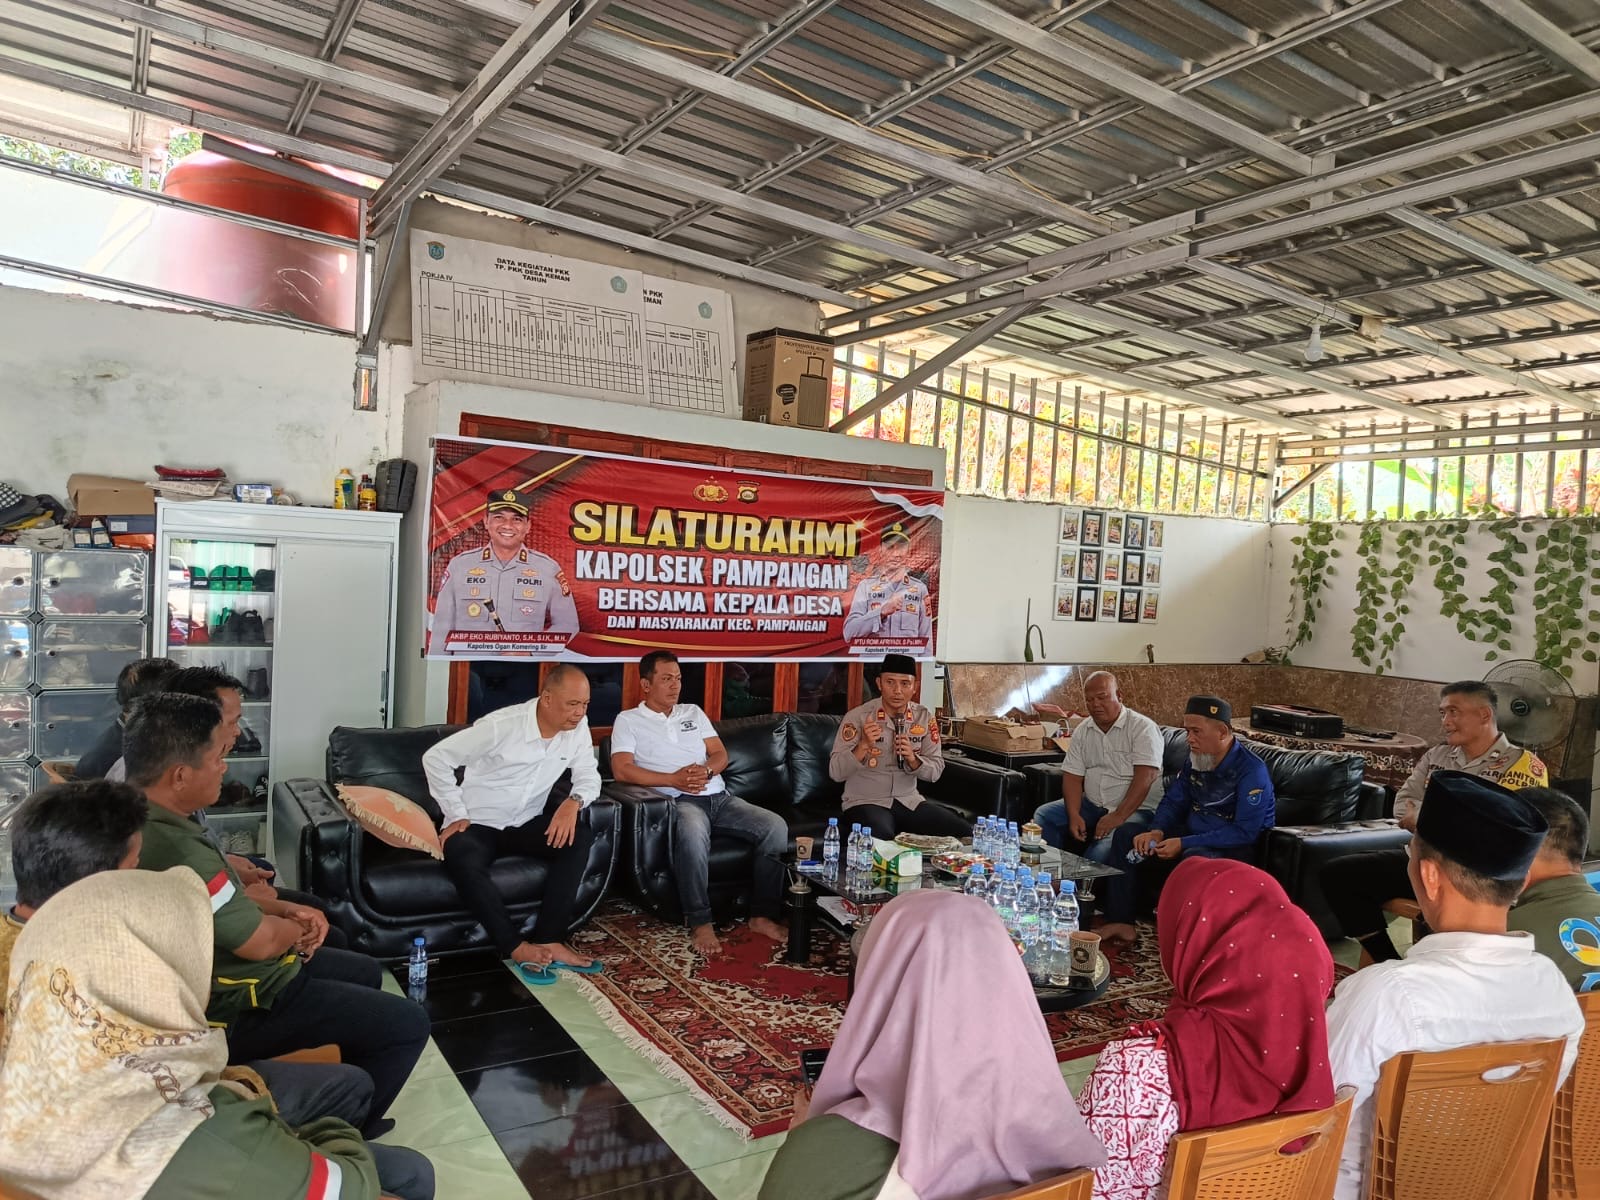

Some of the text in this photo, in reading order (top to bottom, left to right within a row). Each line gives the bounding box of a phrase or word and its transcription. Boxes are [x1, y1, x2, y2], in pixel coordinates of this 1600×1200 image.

[421, 270, 445, 280] POKJA
[497, 257, 570, 276] DATA KEGIATAN PKK
[508, 265, 523, 274] PKK
[525, 268, 543, 277] DESA
[545, 272, 571, 282] KEMAN
[522, 274, 547, 284] TAHUN
[648, 290, 663, 298] PKK
[572, 501, 858, 557] SILATURAHMI
[576, 550, 848, 590] KAPOLSEK PAMPANGAN
[599, 588, 843, 616] BERSAMA KEPALA DESA
[607, 616, 827, 632] DAN MASYARAKAT KEC. PAMPANGAN
